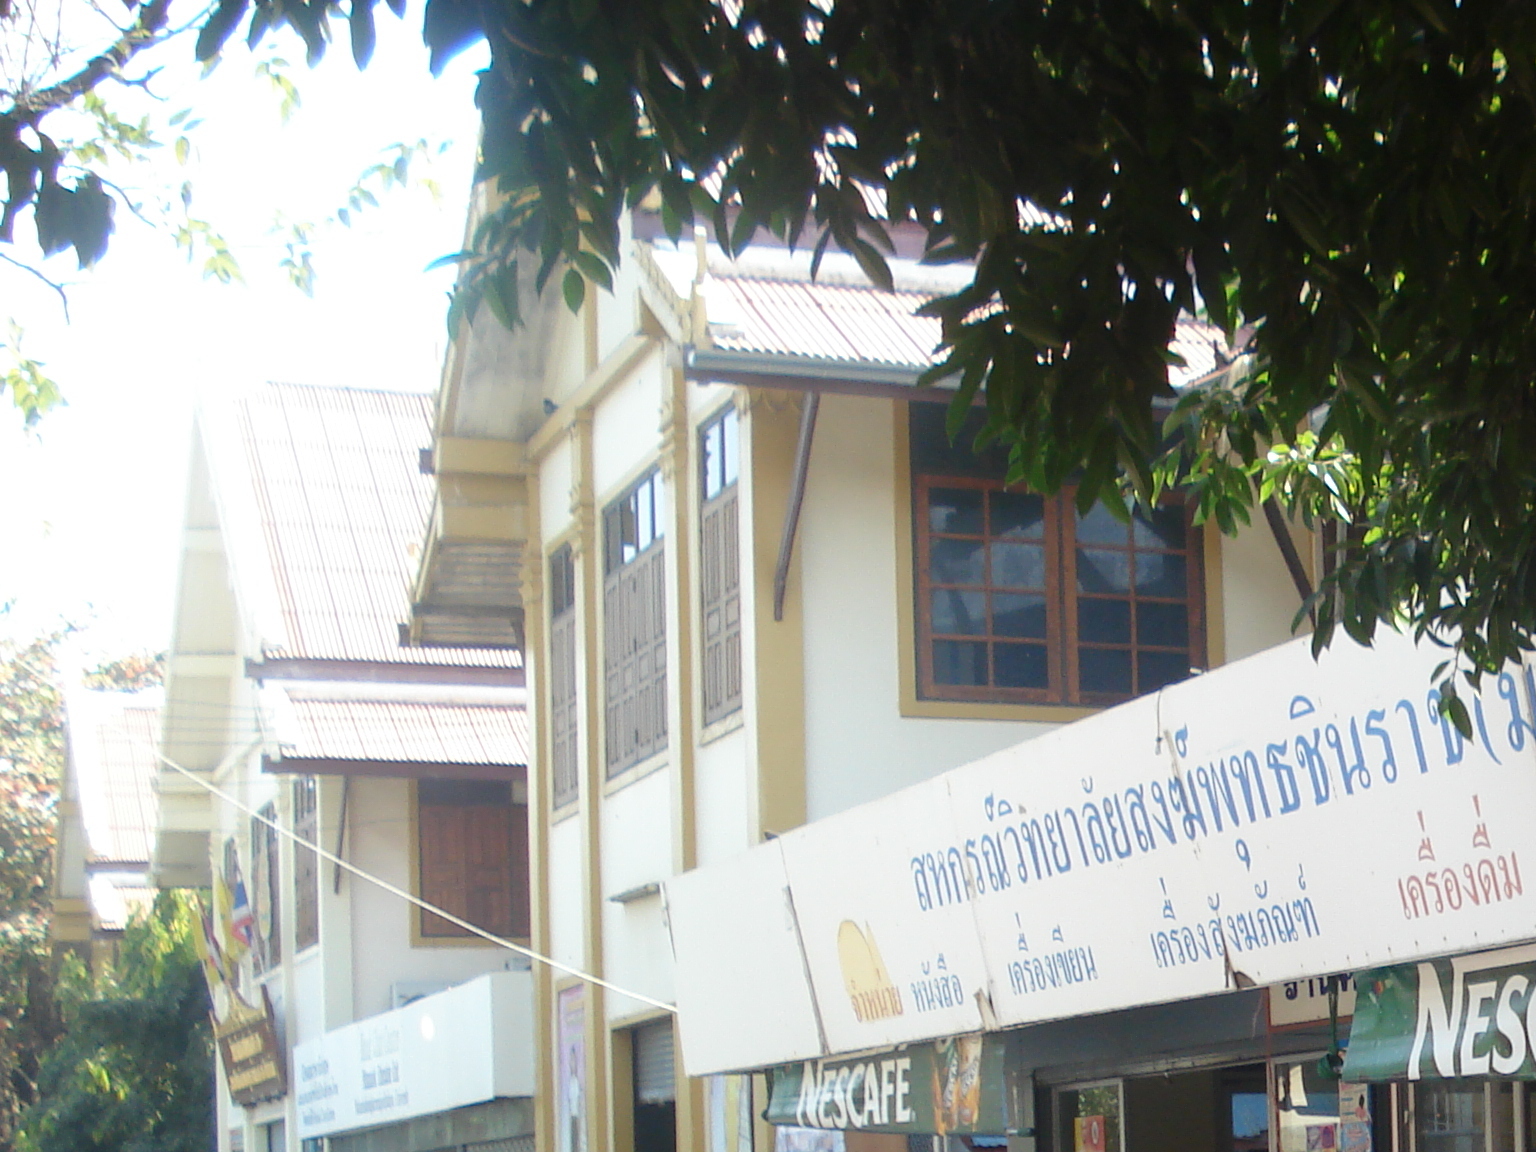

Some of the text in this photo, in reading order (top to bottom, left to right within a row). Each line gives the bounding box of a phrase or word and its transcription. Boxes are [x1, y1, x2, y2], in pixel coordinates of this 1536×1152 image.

[911, 952, 964, 1013] หนังสือ
[1007, 911, 1098, 996] เครื่องเขียน
[1398, 795, 1522, 920] เครื่องดื่ม
